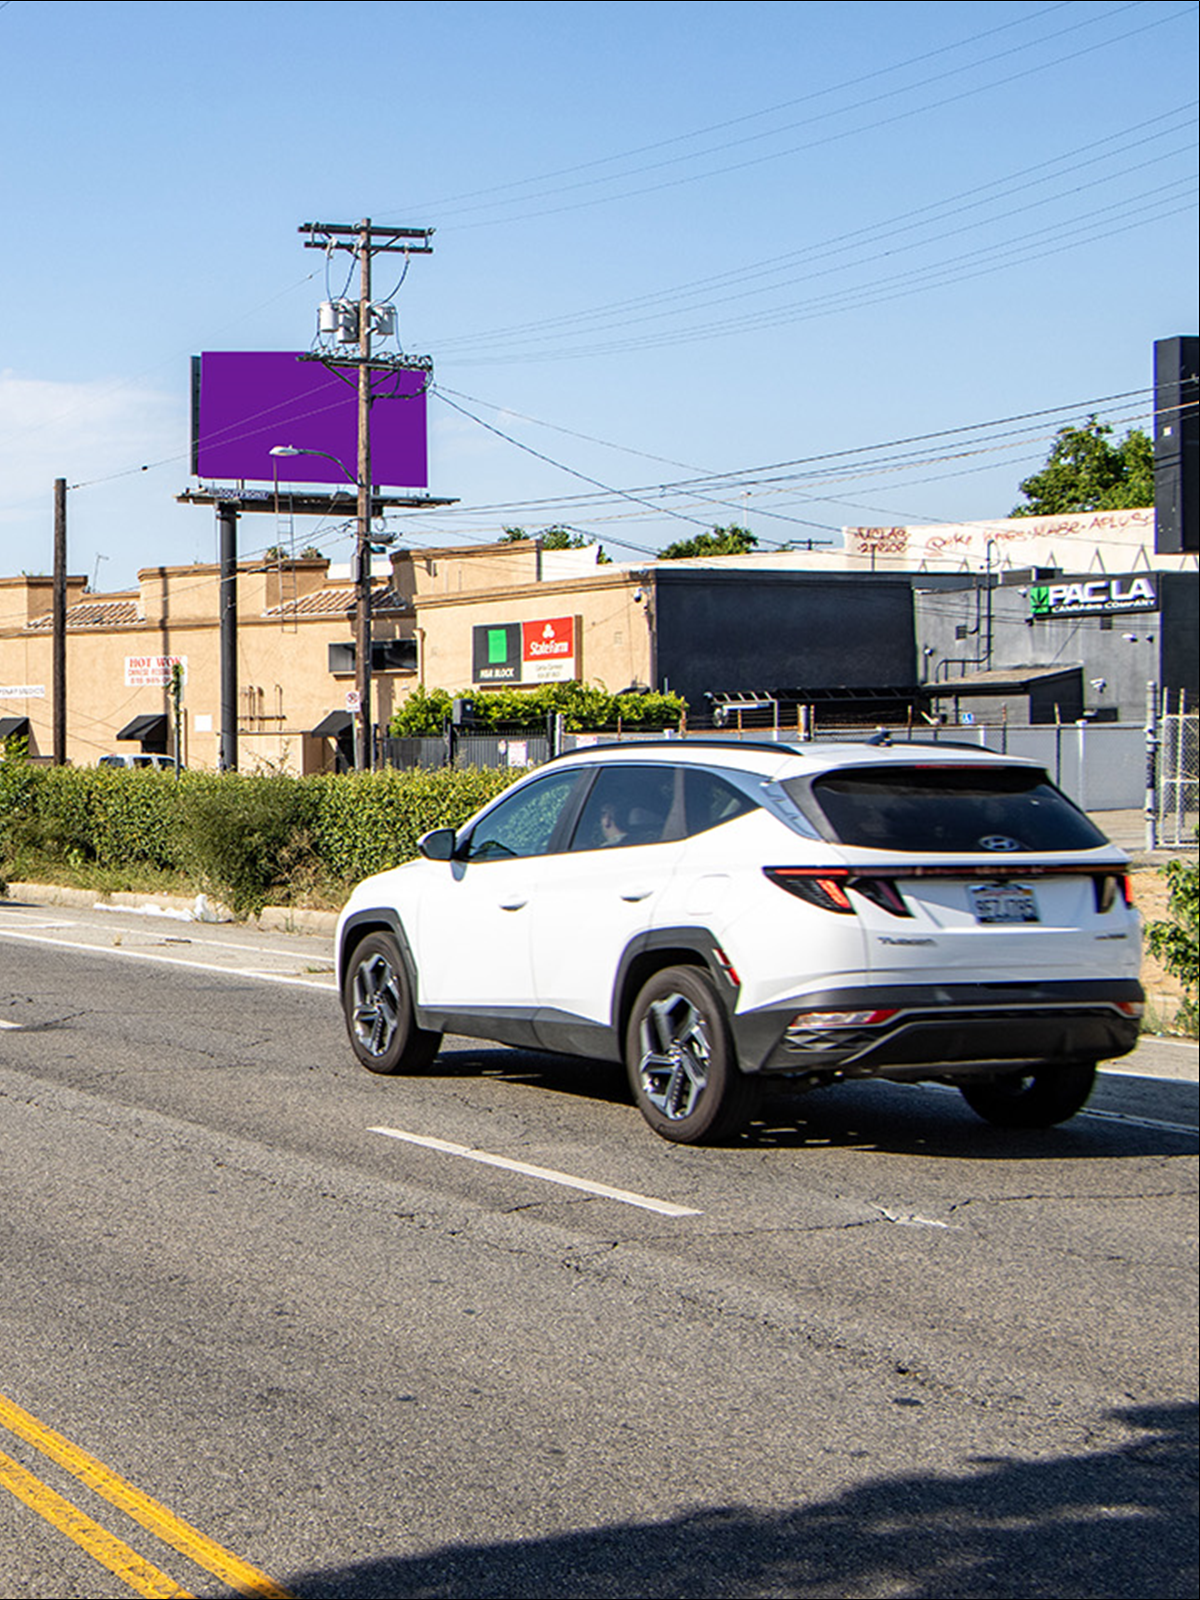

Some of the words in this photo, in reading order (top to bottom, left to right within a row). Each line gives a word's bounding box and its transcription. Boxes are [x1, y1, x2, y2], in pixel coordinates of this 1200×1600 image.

[1049, 581, 1109, 606] PAC
[1111, 578, 1156, 600] LA
[1104, 598, 1157, 610] COMPANY
[129, 657, 152, 668] HOT
[156, 656, 182, 668] WOK
[479, 668, 493, 679] H&R
[494, 667, 515, 678] BLOCK
